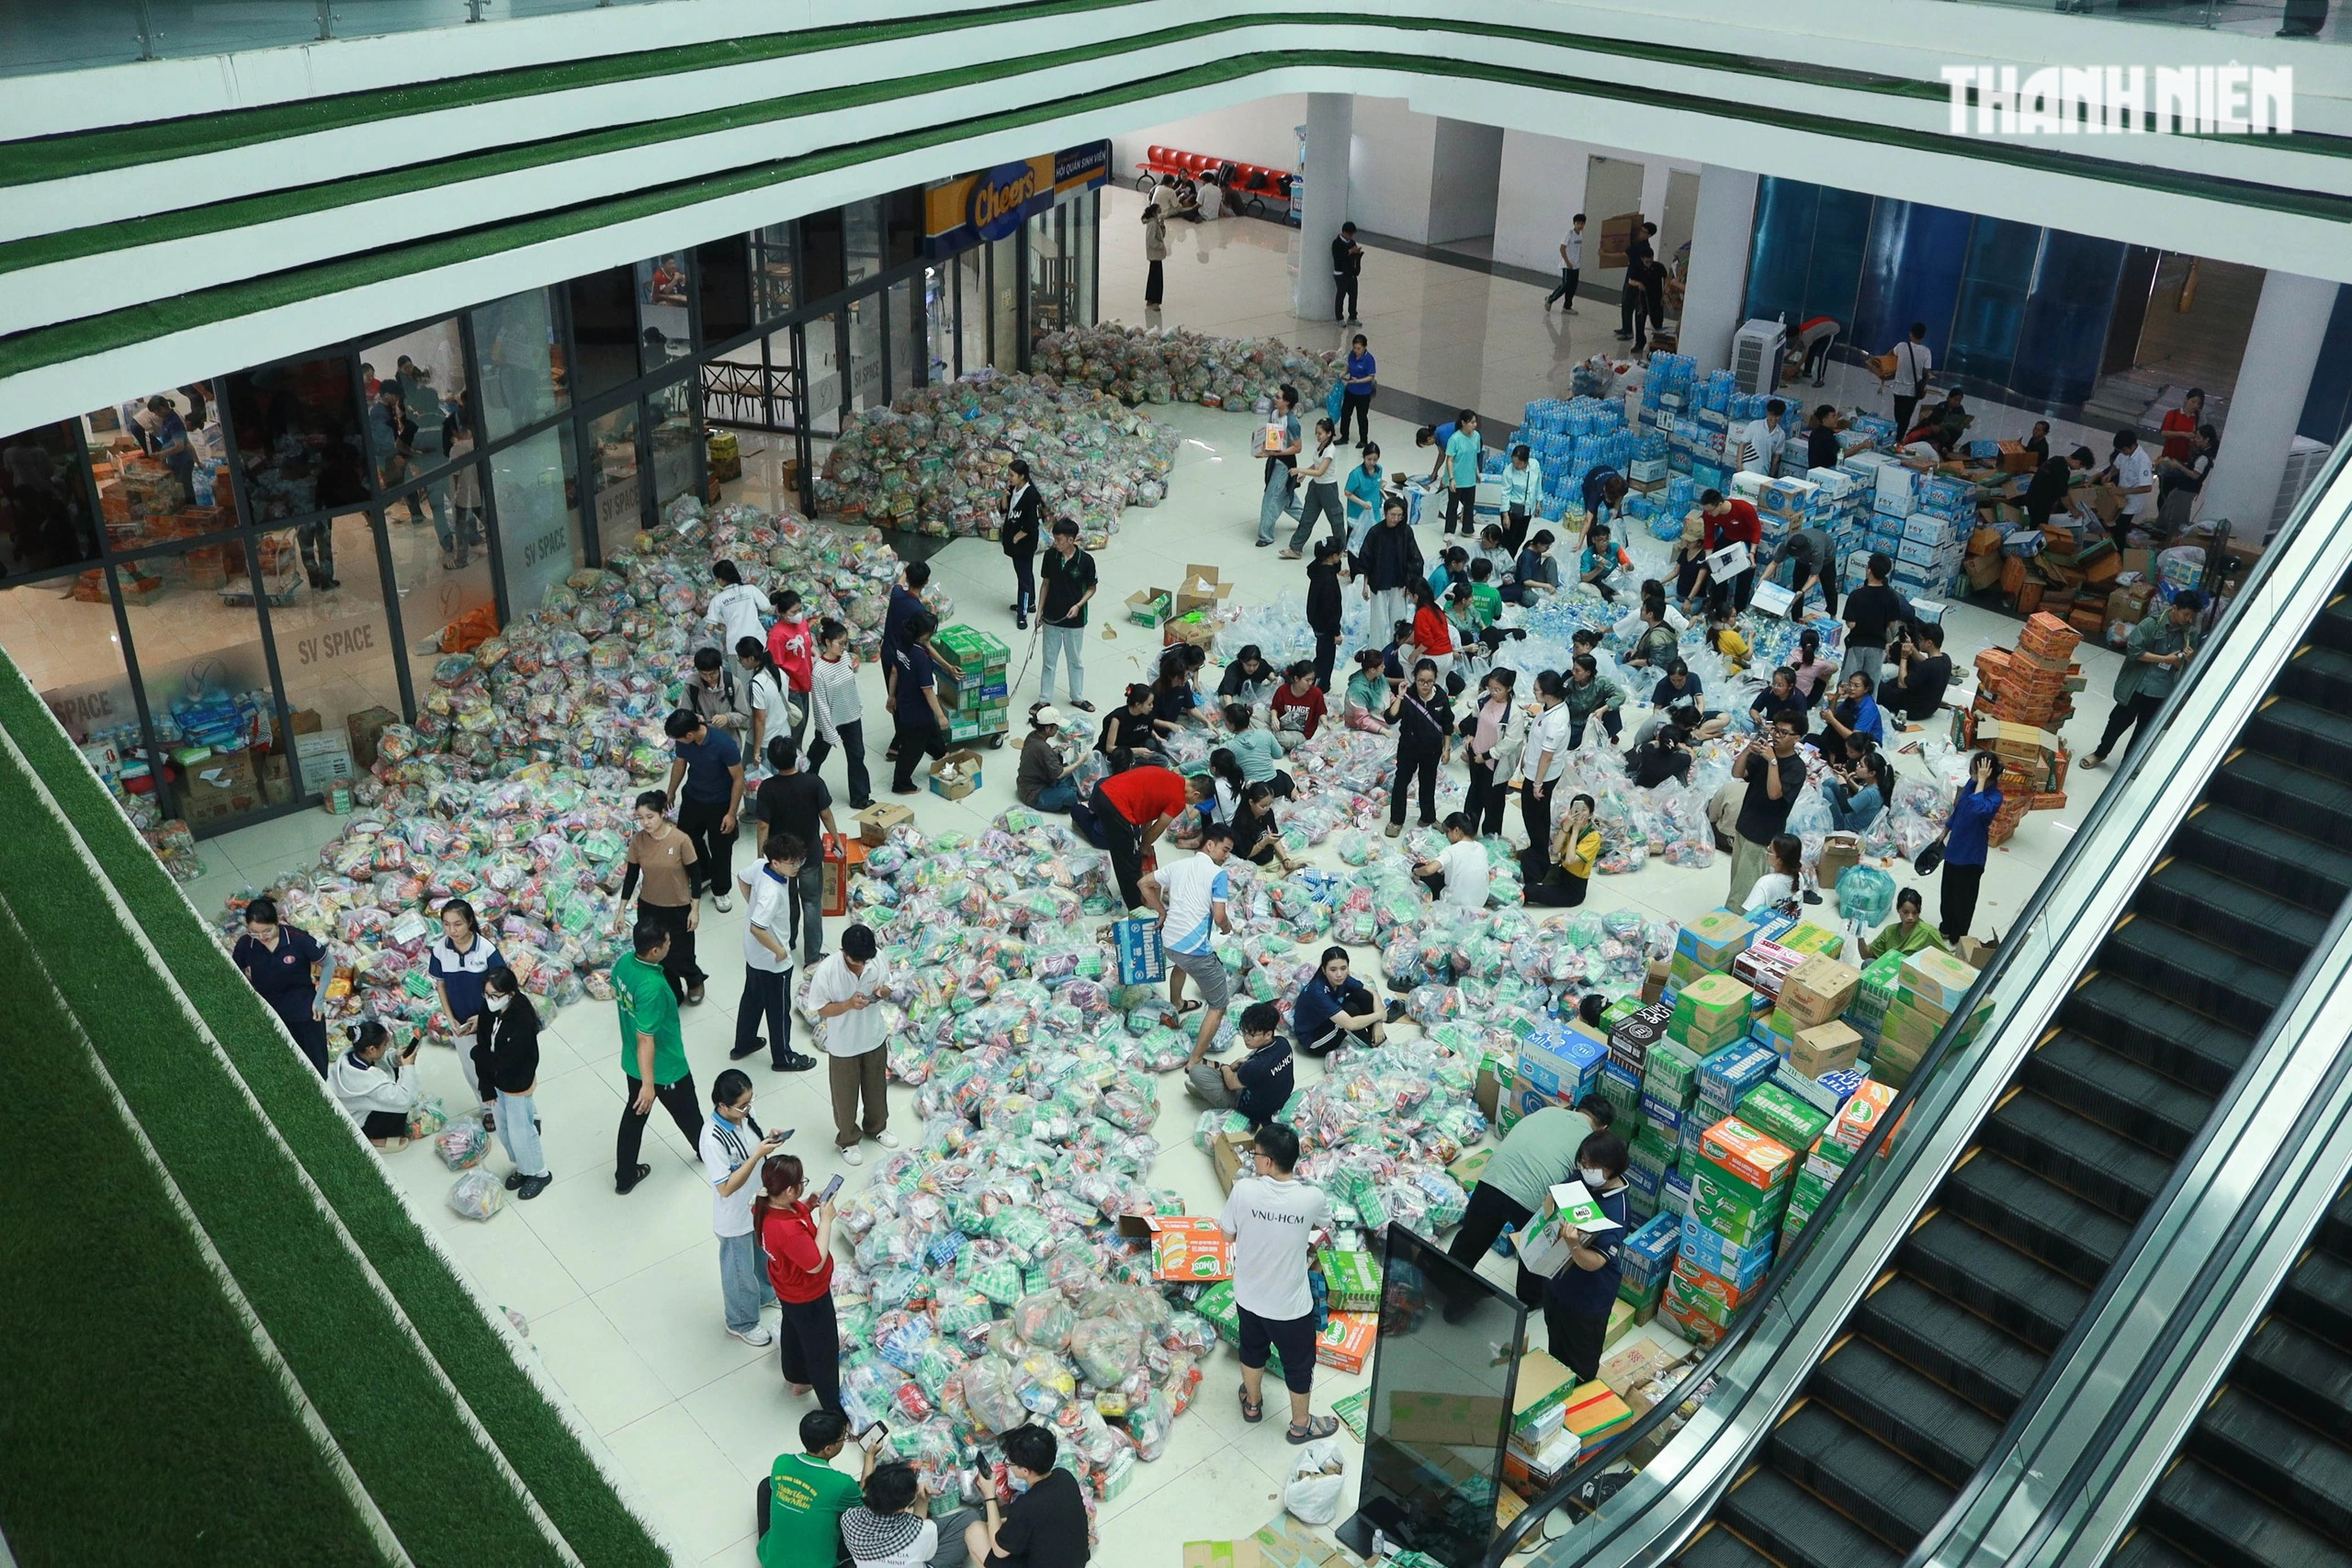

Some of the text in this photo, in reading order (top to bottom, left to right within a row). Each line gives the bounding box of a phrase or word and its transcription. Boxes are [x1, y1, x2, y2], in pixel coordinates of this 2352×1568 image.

[975, 170, 1034, 227] Cheers
[525, 526, 566, 567] SV SPACE
[299, 625, 375, 665] SV SPACE
[53, 691, 113, 724] SPACE
[1722, 1047, 1775, 1079] Vinamilk
[1752, 1093, 1813, 1133] Vinamilk
[1251, 1209, 1305, 1224] VNU-HCM
